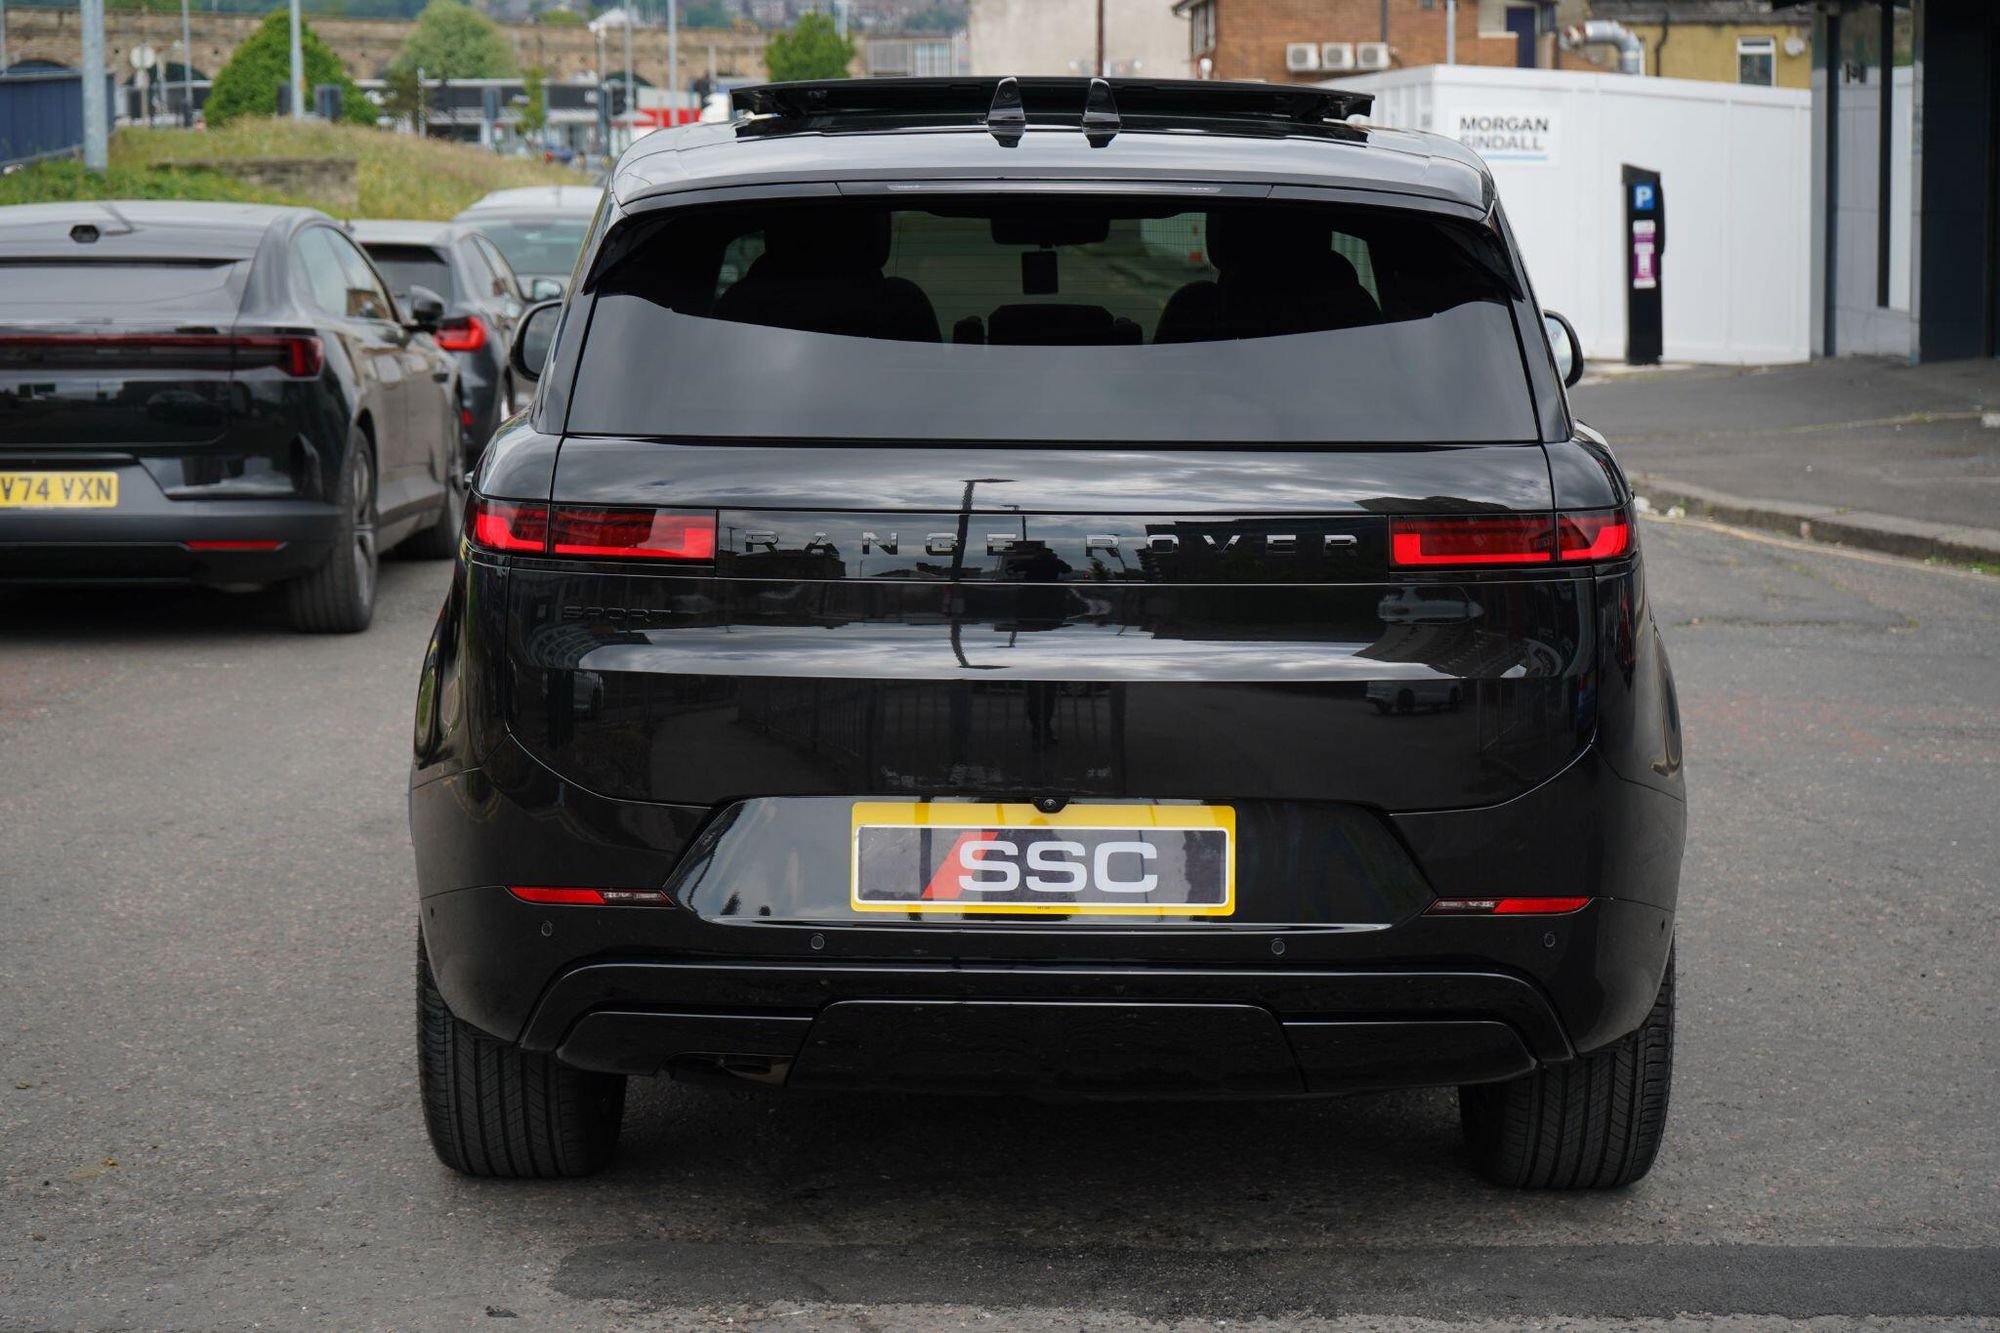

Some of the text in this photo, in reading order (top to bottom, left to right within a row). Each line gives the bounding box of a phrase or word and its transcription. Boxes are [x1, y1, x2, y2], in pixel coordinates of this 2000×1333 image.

[1459, 116, 1548, 132] MORGAN
[1635, 185, 1653, 208] P
[61, 477, 112, 501] VXN
[745, 530, 1358, 558] RANGE ROVER
[957, 840, 1159, 893] SSC
